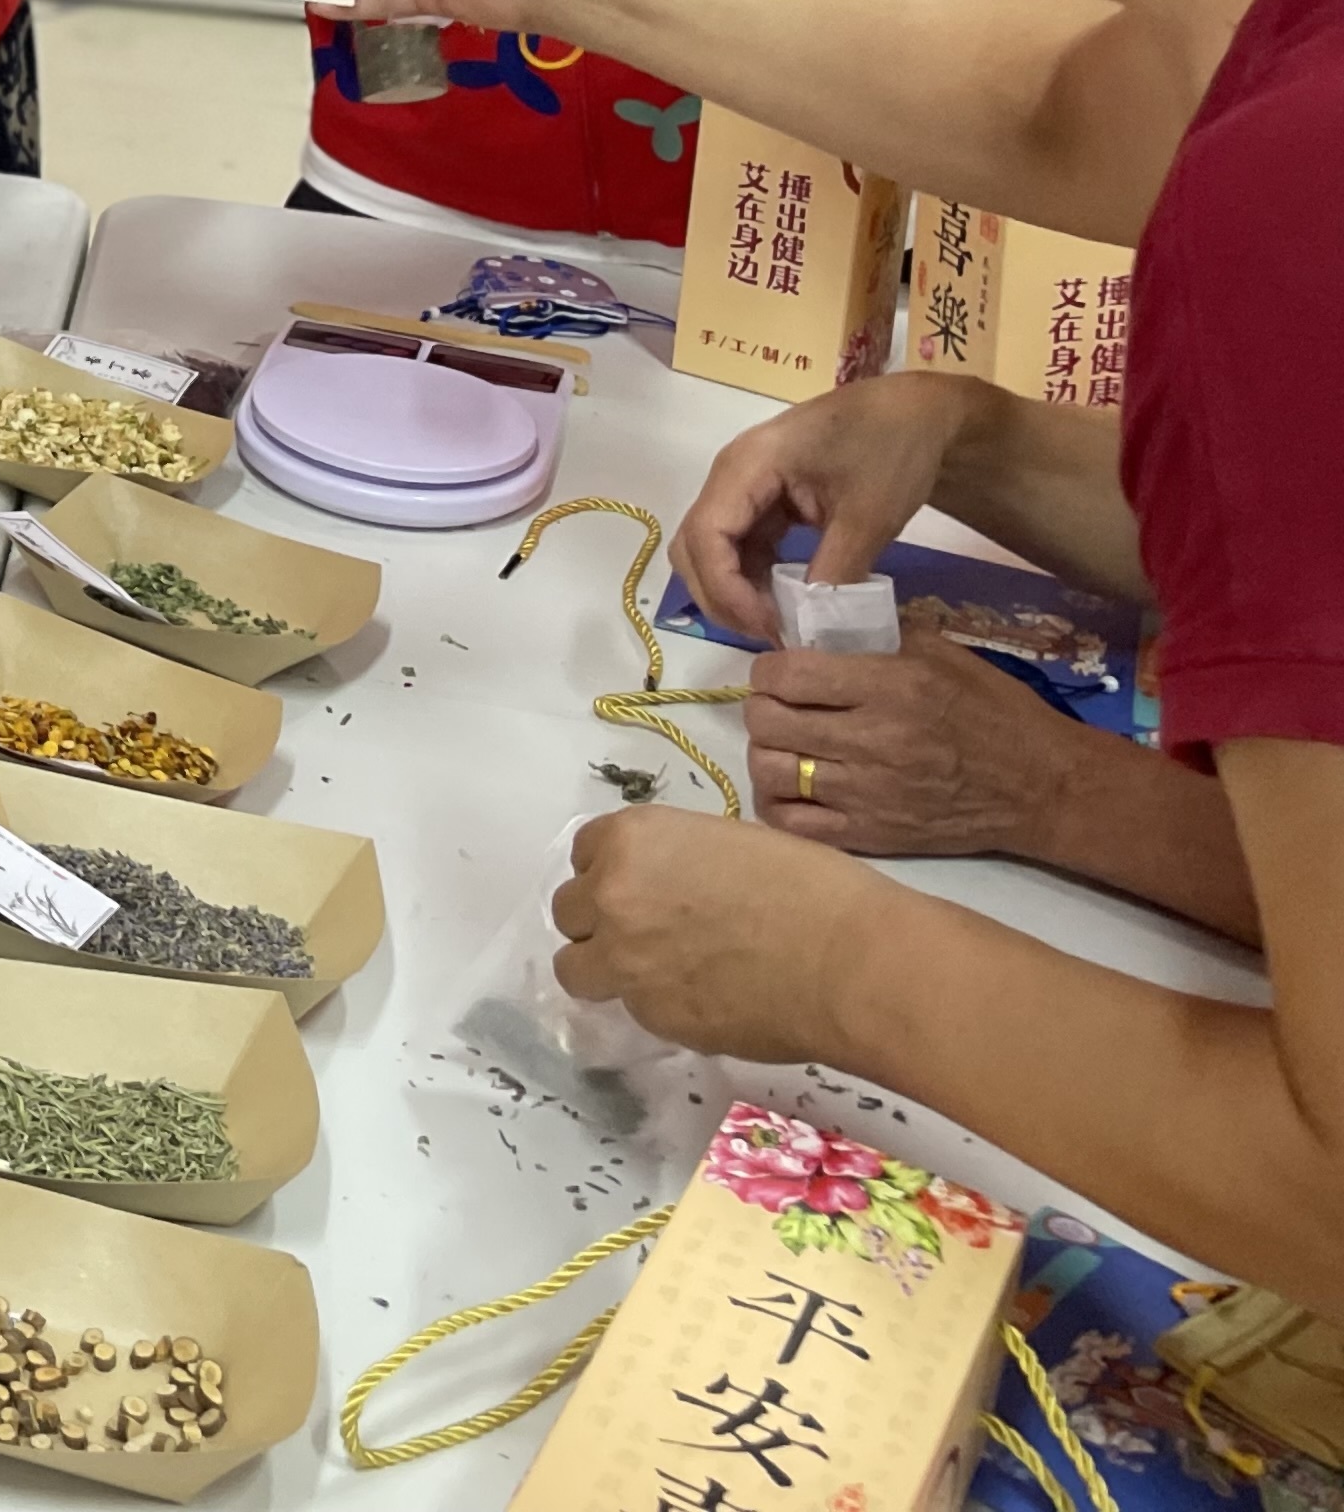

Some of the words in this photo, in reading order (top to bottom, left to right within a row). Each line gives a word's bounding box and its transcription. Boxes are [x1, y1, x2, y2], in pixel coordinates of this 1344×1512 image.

[728, 160, 771, 286] 艾在身边
[766, 170, 812, 296] 捶出健康
[1043, 277, 1088, 405] 艾在身边
[620, 1270, 871, 1511] 平安
